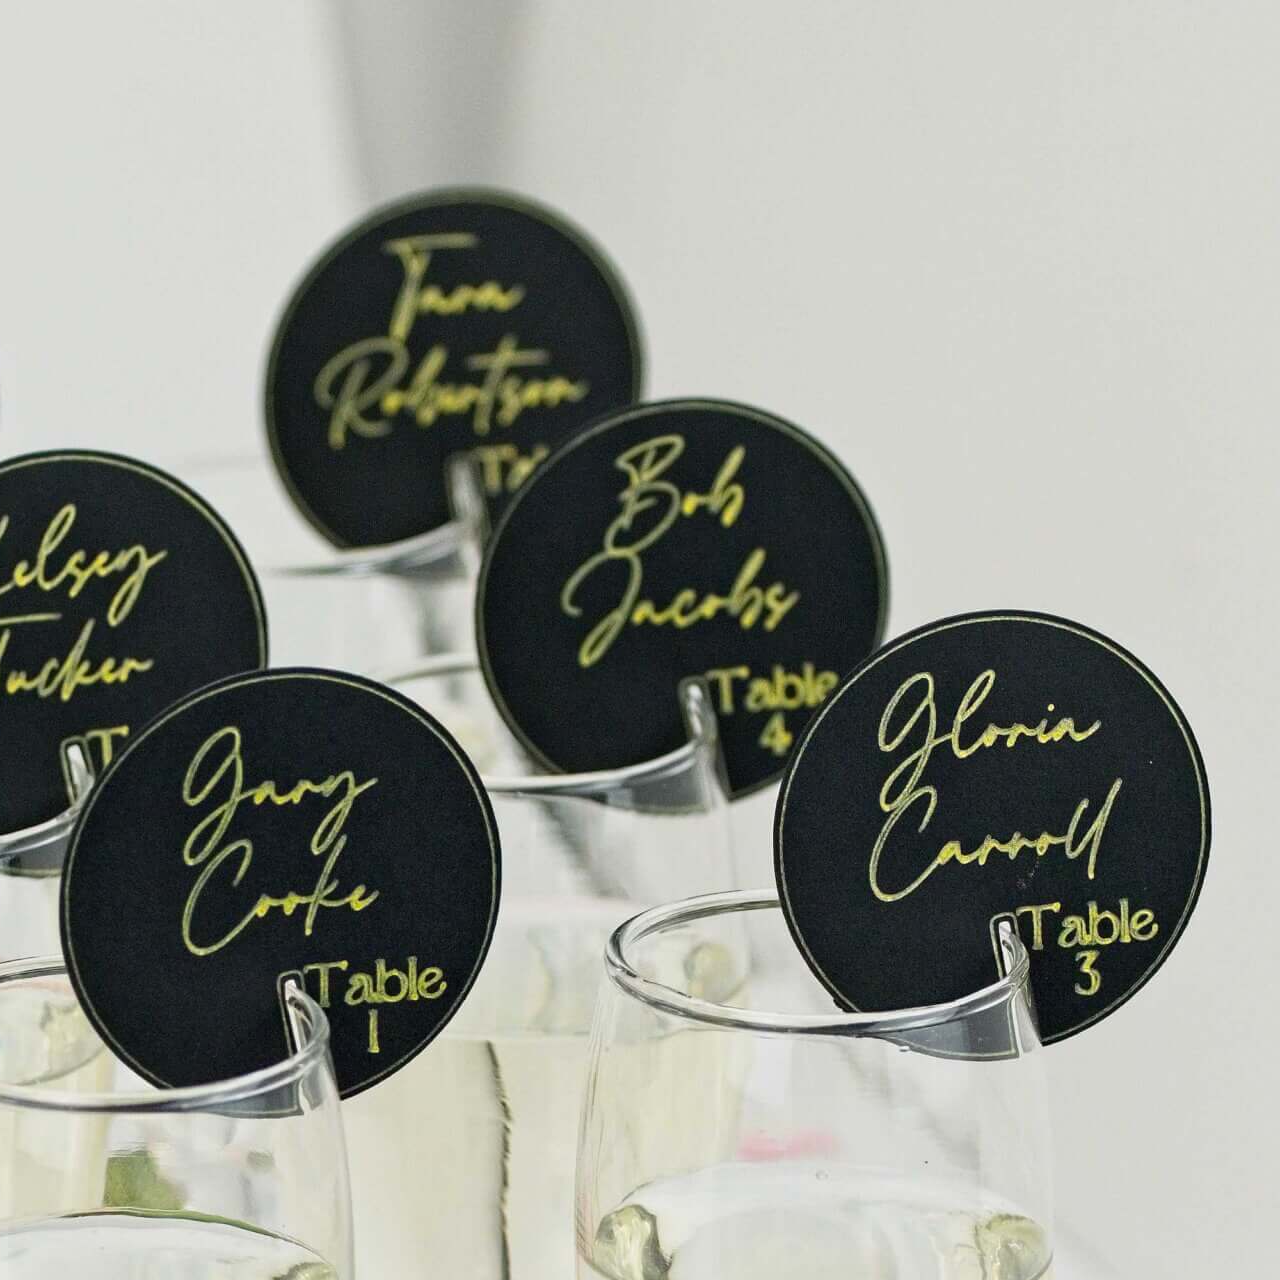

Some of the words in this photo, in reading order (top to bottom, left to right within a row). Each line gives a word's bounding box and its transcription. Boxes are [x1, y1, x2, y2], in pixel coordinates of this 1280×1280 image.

[384, 231, 526, 342] Tara
[314, 336, 588, 450] Robertson
[604, 433, 746, 557] Bob
[559, 547, 802, 669] Jacobs
[758, 713, 794, 756] 4
[878, 669, 1102, 813] Gloria
[182, 726, 379, 866] Gary
[869, 776, 1123, 903] Carroll
[181, 834, 381, 956] Cooke
[1016, 898, 1160, 952] Table
[303, 955, 448, 1008] Table
[1074, 950, 1101, 997] 3
[367, 1008, 380, 1054] 1
